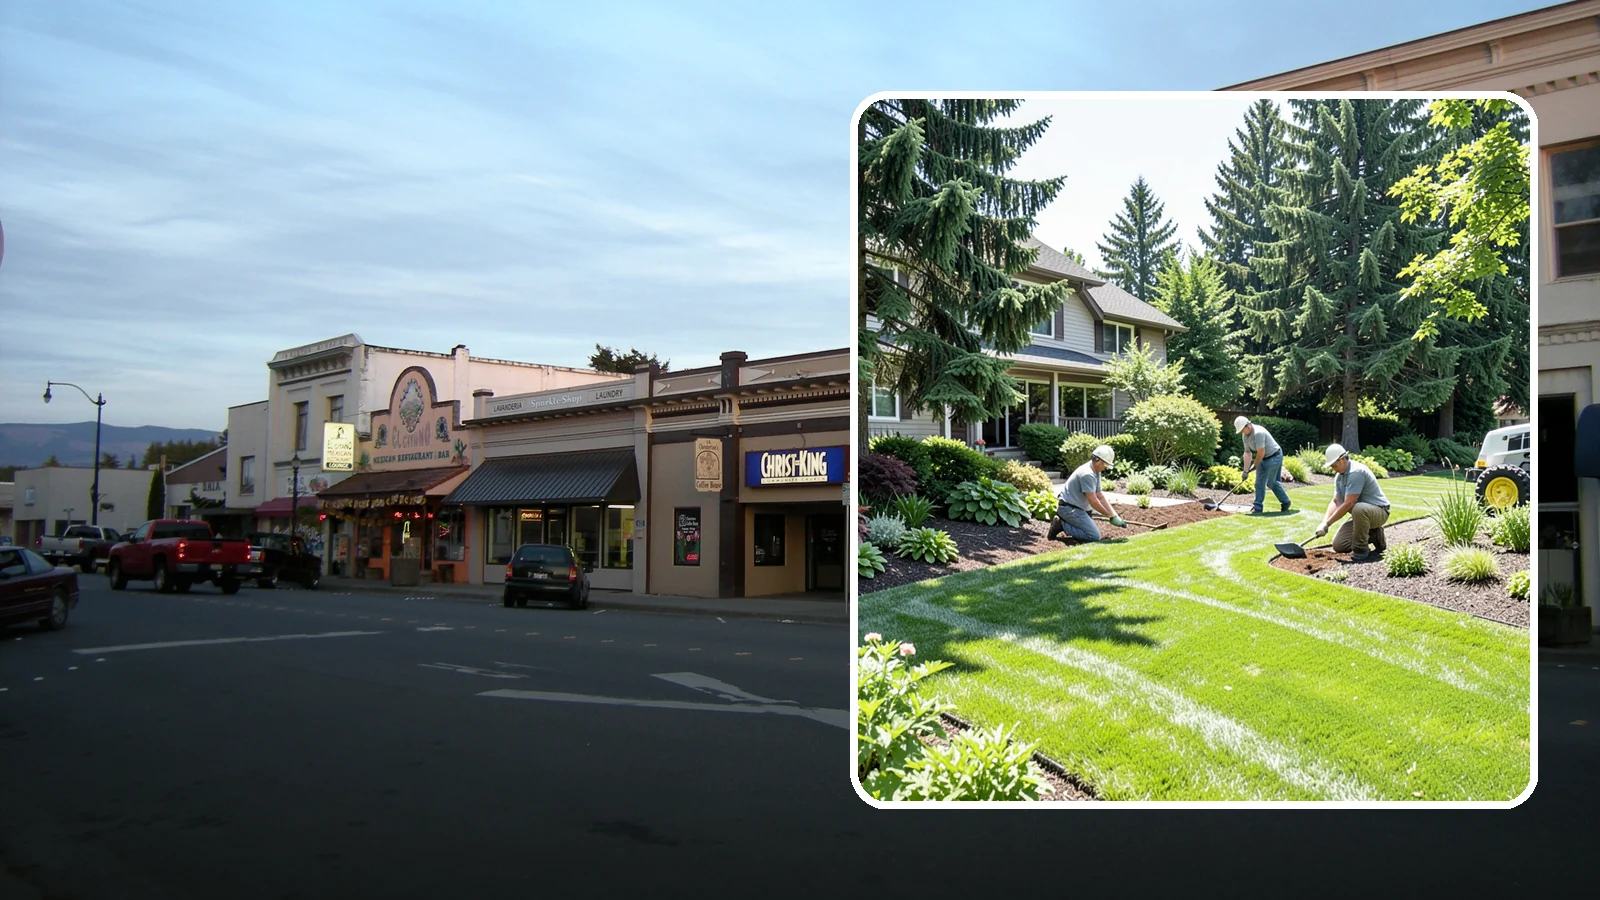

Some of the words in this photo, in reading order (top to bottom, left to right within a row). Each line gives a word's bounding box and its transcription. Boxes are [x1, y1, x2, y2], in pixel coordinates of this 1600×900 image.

[493, 402, 522, 412] LAVANDERIA
[531, 398, 561, 409] Sparkle
[562, 394, 583, 406] Shop
[595, 389, 624, 400] LAUNDRY
[373, 455, 396, 464] MEXICAN
[397, 451, 433, 462] RESTAURANT
[438, 450, 450, 459] BAR
[760, 452, 797, 478] CHRIST
[798, 450, 828, 476] KING
[696, 481, 709, 489] Coffee
[709, 481, 722, 489] House
